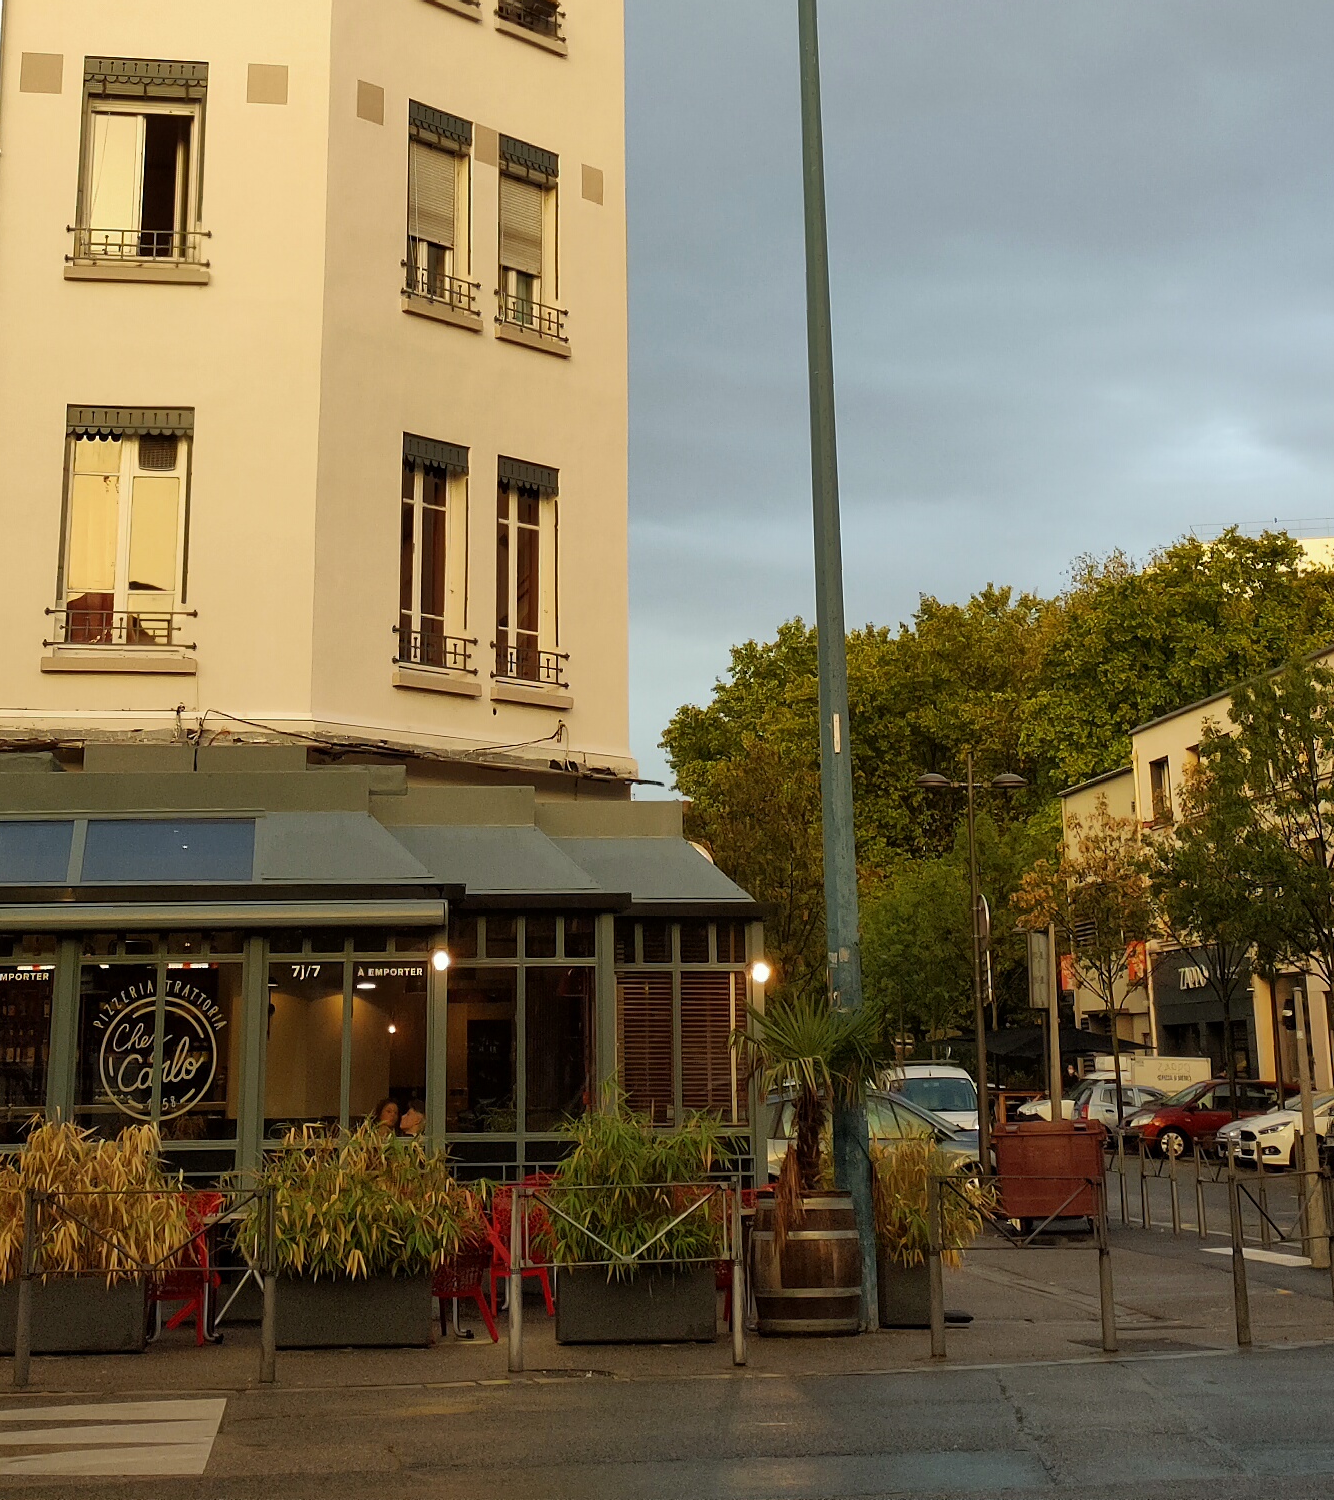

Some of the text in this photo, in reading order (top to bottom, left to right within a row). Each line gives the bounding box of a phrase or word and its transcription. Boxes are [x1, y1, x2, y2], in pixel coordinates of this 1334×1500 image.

[291, 964, 321, 981] 7j/7
[367, 967, 423, 977] EMPORTER
[93, 979, 228, 1031] PIZZERIA TRATTORIA
[117, 1036, 205, 1093] Carlo
[146, 1095, 176, 1112] 158
